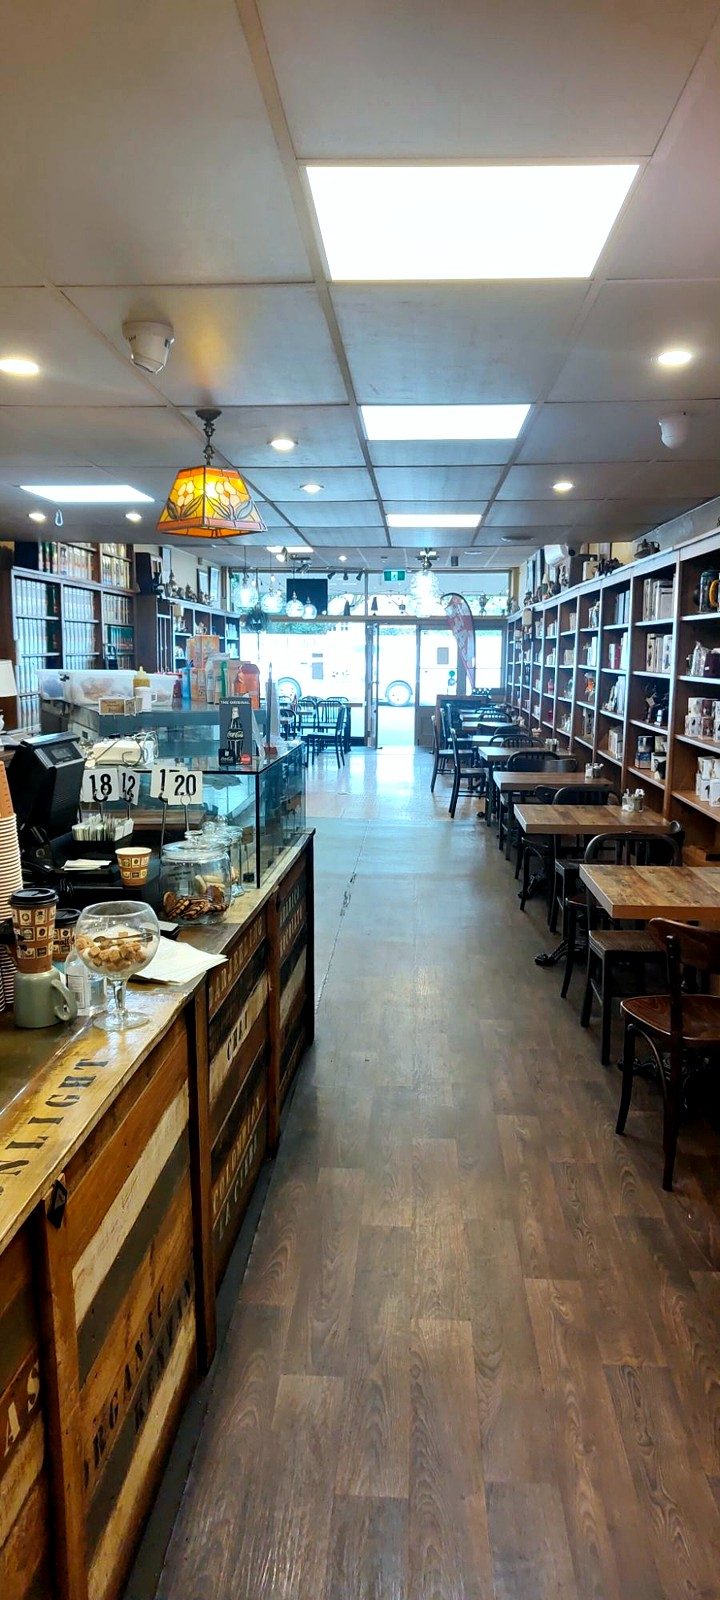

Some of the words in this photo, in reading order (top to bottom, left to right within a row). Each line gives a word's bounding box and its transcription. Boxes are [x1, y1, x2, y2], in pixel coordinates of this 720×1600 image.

[89, 773, 113, 799] 18
[122, 772, 136, 802] 12
[174, 774, 197, 796] 20
[225, 1011, 250, 1062] CHAI
[0, 1057, 109, 1196] NLIGHT
[213, 1095, 260, 1214] COLOMBIAN
